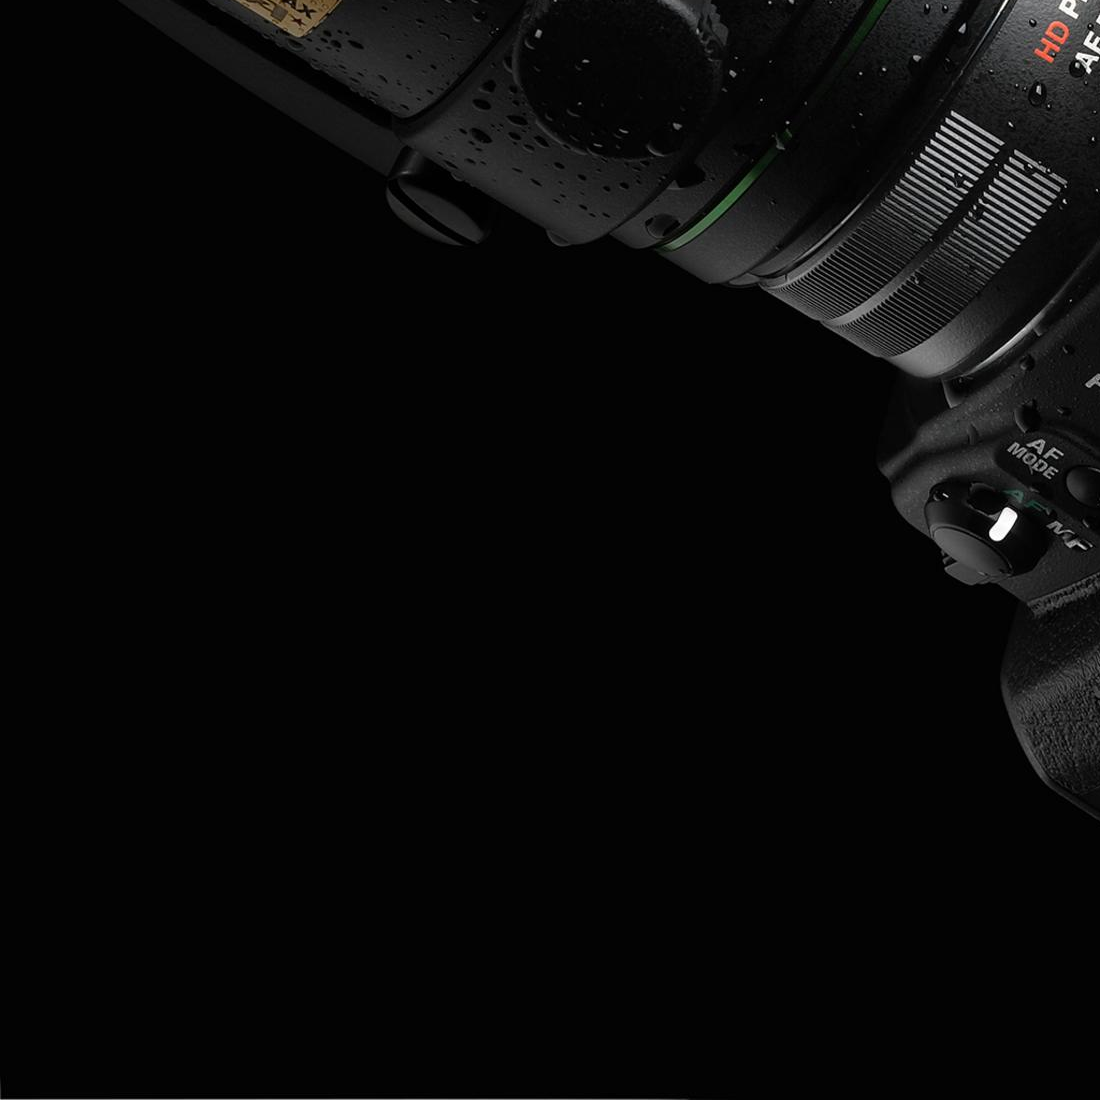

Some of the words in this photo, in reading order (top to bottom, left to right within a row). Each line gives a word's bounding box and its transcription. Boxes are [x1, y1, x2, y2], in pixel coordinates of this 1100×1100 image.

[1033, 20, 1070, 64] HD
[1006, 441, 1059, 480] MODE
[1026, 438, 1064, 462] AF
[1047, 519, 1094, 552] MF
